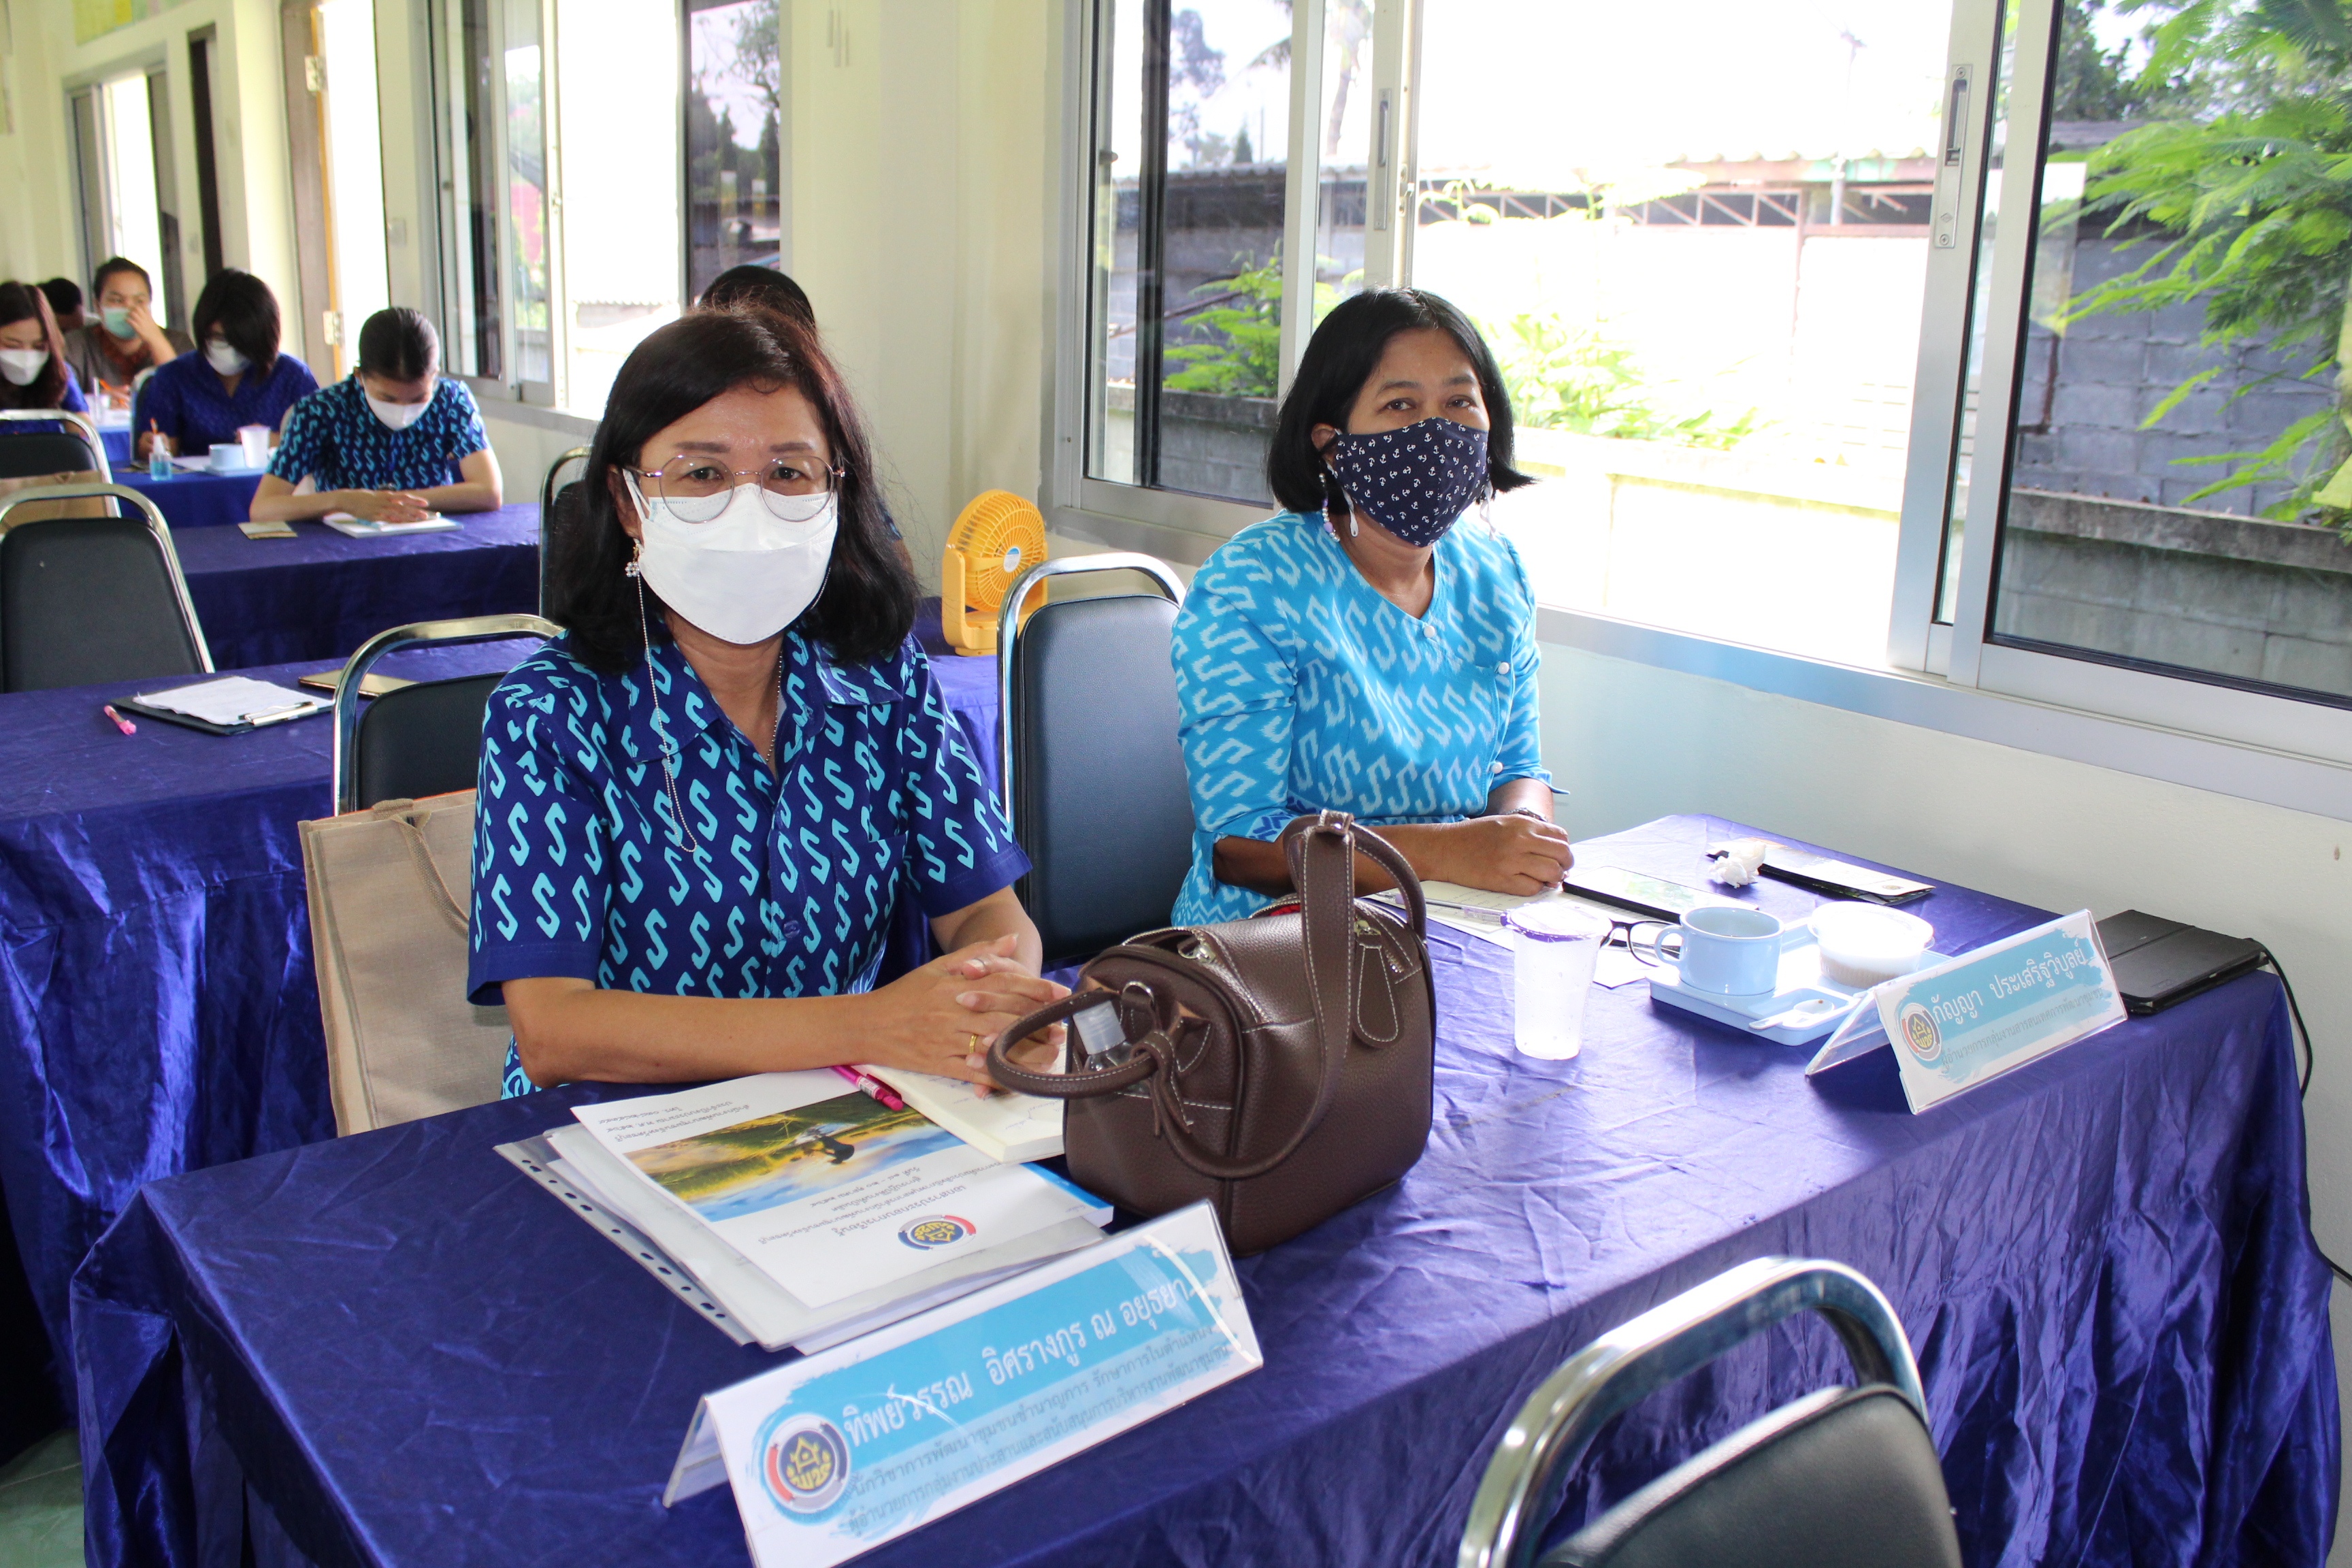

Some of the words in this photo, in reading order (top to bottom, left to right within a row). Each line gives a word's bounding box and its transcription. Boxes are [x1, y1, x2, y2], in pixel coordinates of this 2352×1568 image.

[1931, 991, 1983, 1026] กัญญา
[1989, 941, 2087, 1000] ประเสริฐวิบูลย์
[1940, 988, 2103, 1073] ผู้อำนวยการกลุ่มงานสารสนเทศการพัฒนาชุมชน
[831, 1185, 966, 1237] เอกสารประกอบการเรียนรู้
[838, 1185, 864, 1199] ตุลาคม
[900, 1166, 920, 1179] วันที่
[843, 1371, 973, 1448] ทิพย์วรรณ
[981, 1320, 1087, 1386] อิศรางกูร
[1090, 1310, 1117, 1341] ณ
[1119, 1278, 1191, 1330] อยุธยา
[853, 1381, 1090, 1496] นักวิชาการพัฒนาชุมชนชำนาญการ
